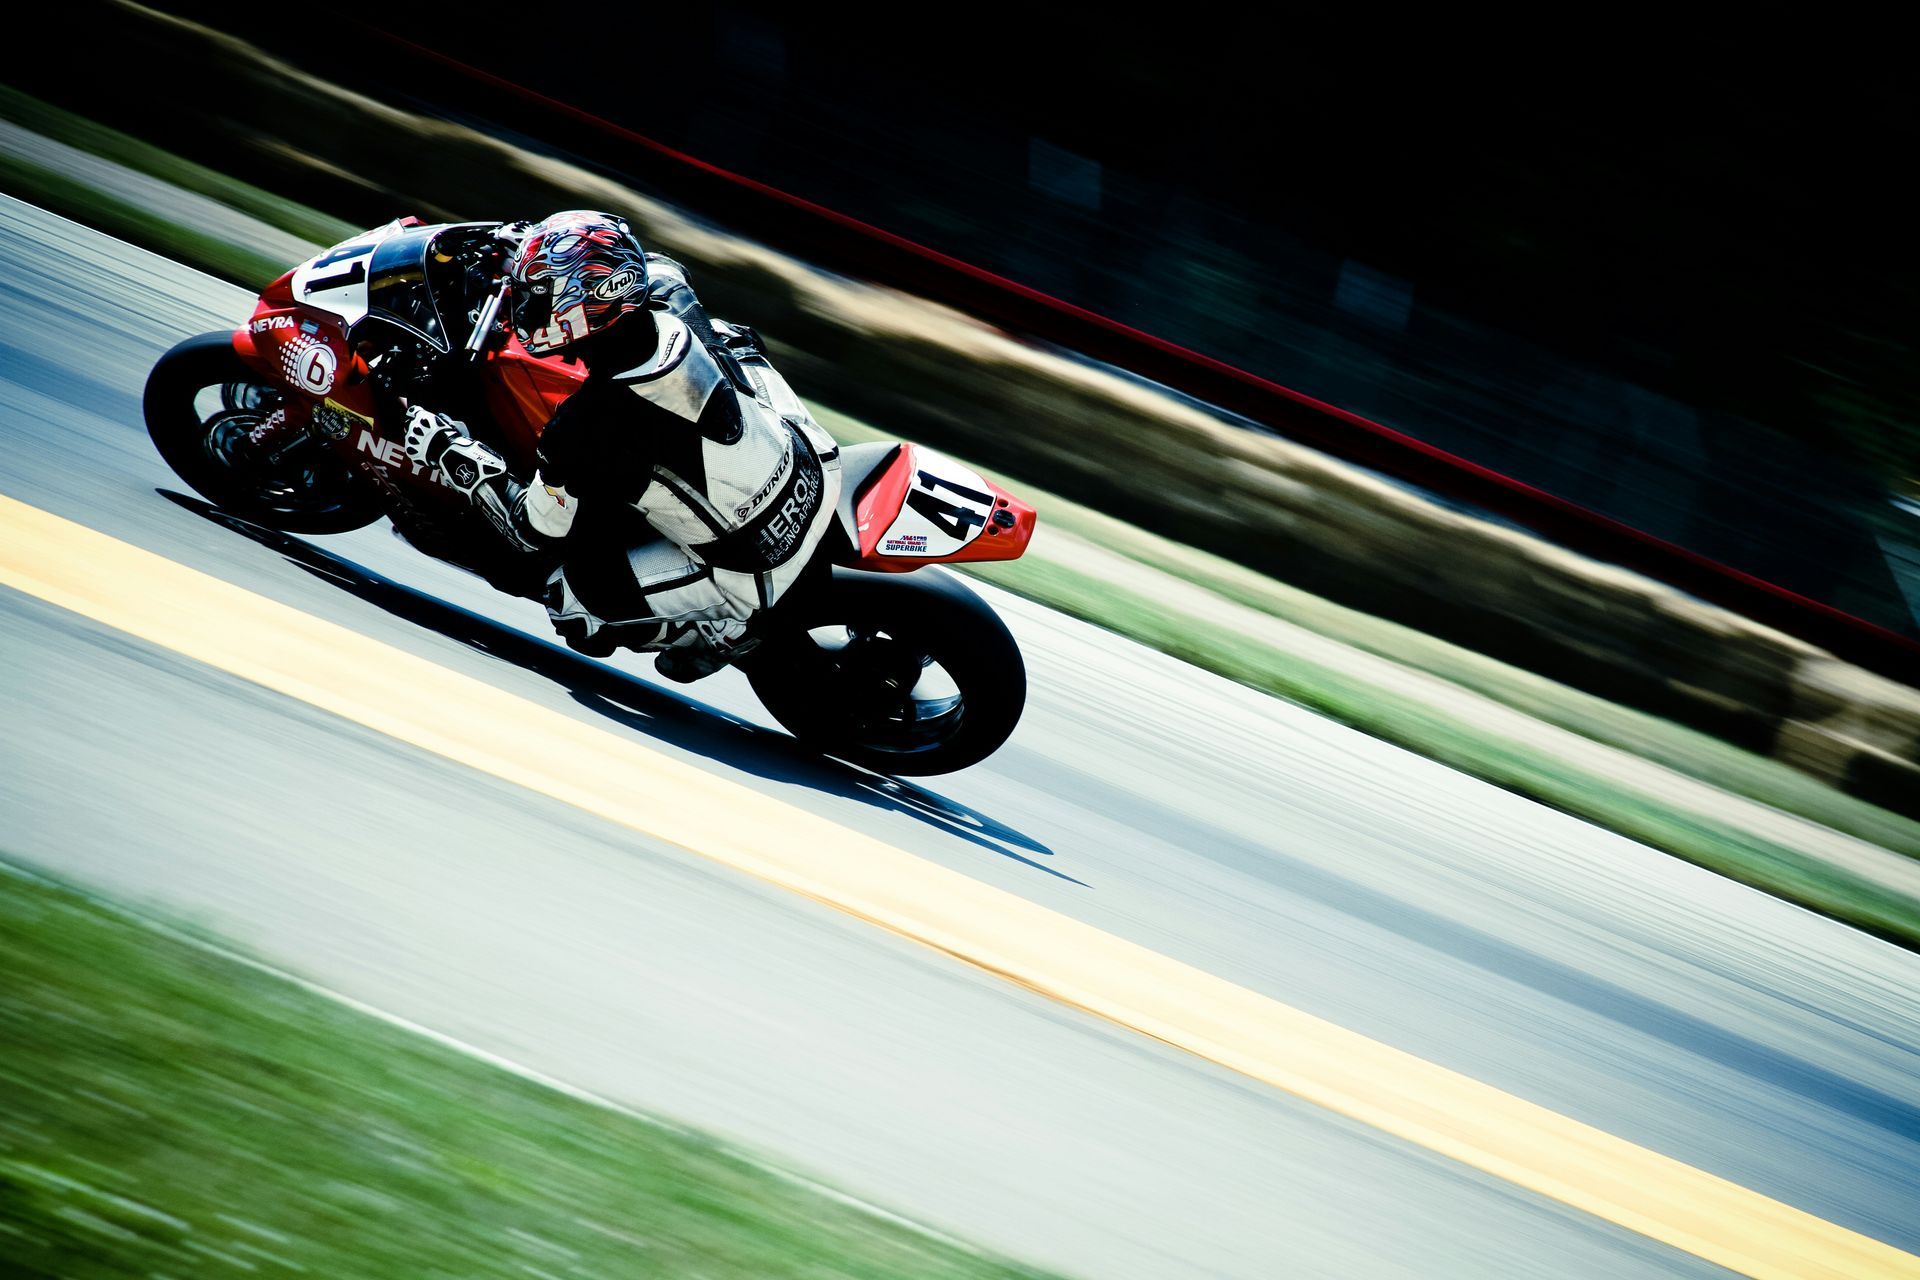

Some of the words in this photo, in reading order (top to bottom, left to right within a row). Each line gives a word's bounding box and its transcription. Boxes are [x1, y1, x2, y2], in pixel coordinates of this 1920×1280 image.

[601, 271, 637, 298] Arai
[252, 316, 294, 334] NEYRA
[533, 302, 590, 347] 41
[751, 450, 790, 509] DUNLO
[906, 469, 995, 542] 41
[767, 522, 801, 564] RACING
[885, 544, 928, 553] SUPERBIKE
